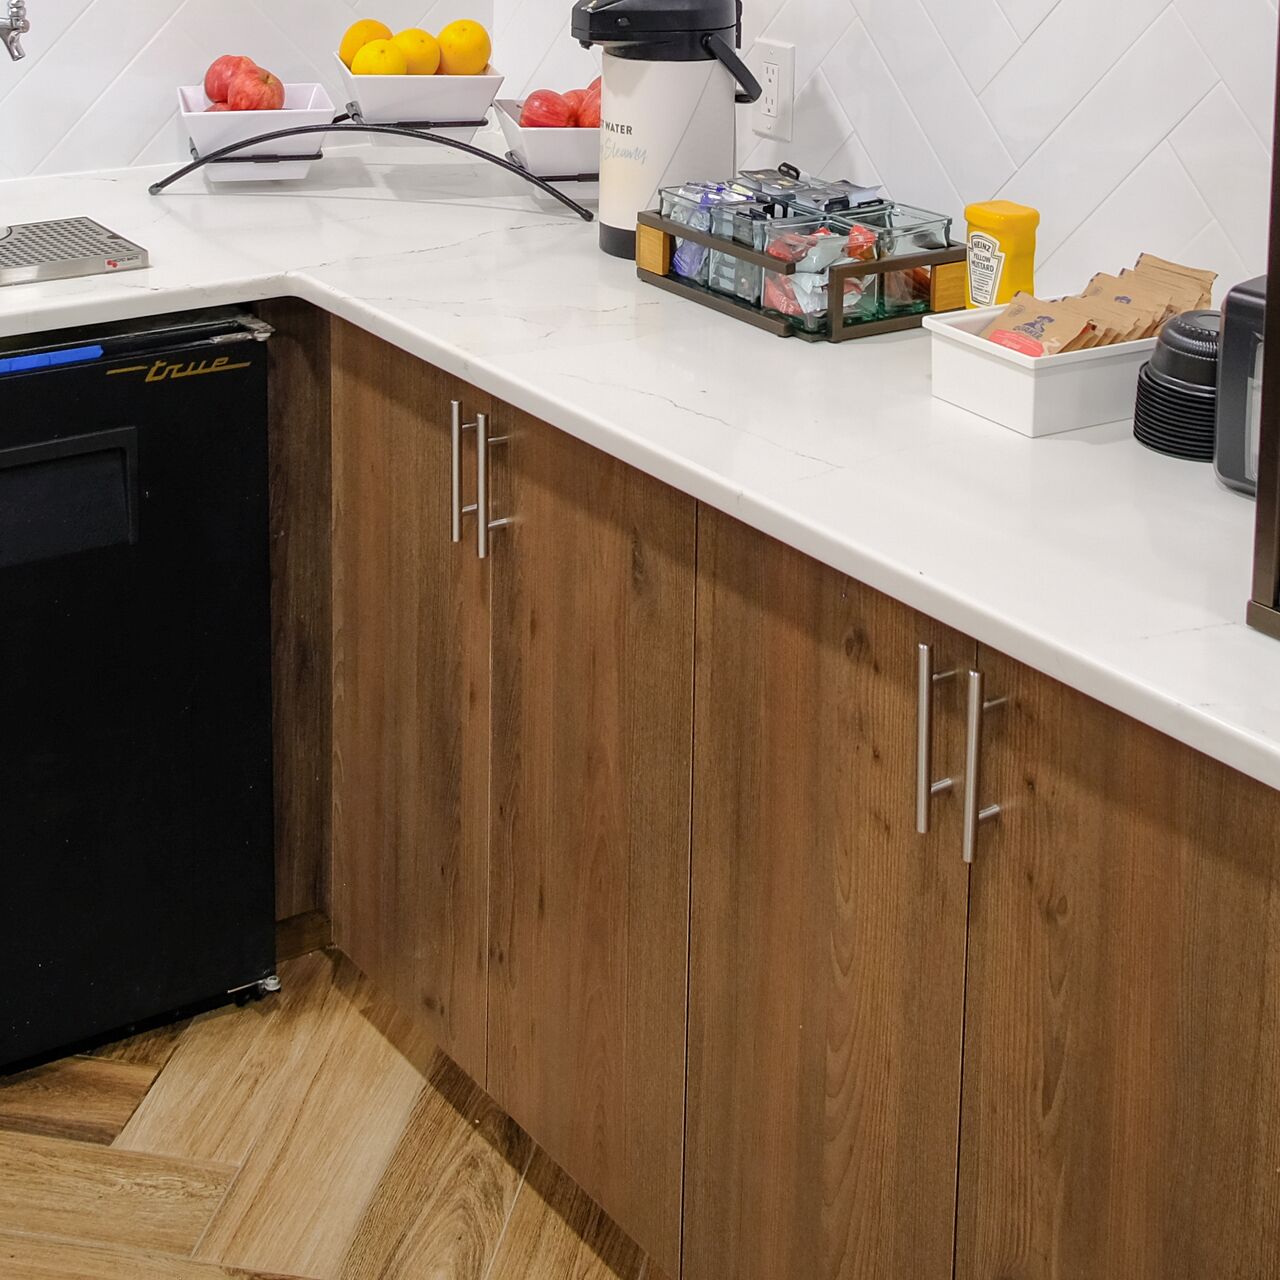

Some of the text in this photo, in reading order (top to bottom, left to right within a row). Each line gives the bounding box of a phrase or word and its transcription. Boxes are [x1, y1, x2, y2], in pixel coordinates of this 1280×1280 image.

[605, 121, 633, 135] WATER
[973, 241, 991, 252] HEINZ
[973, 252, 991, 264] YELLOW
[972, 260, 994, 272] MUSTARD
